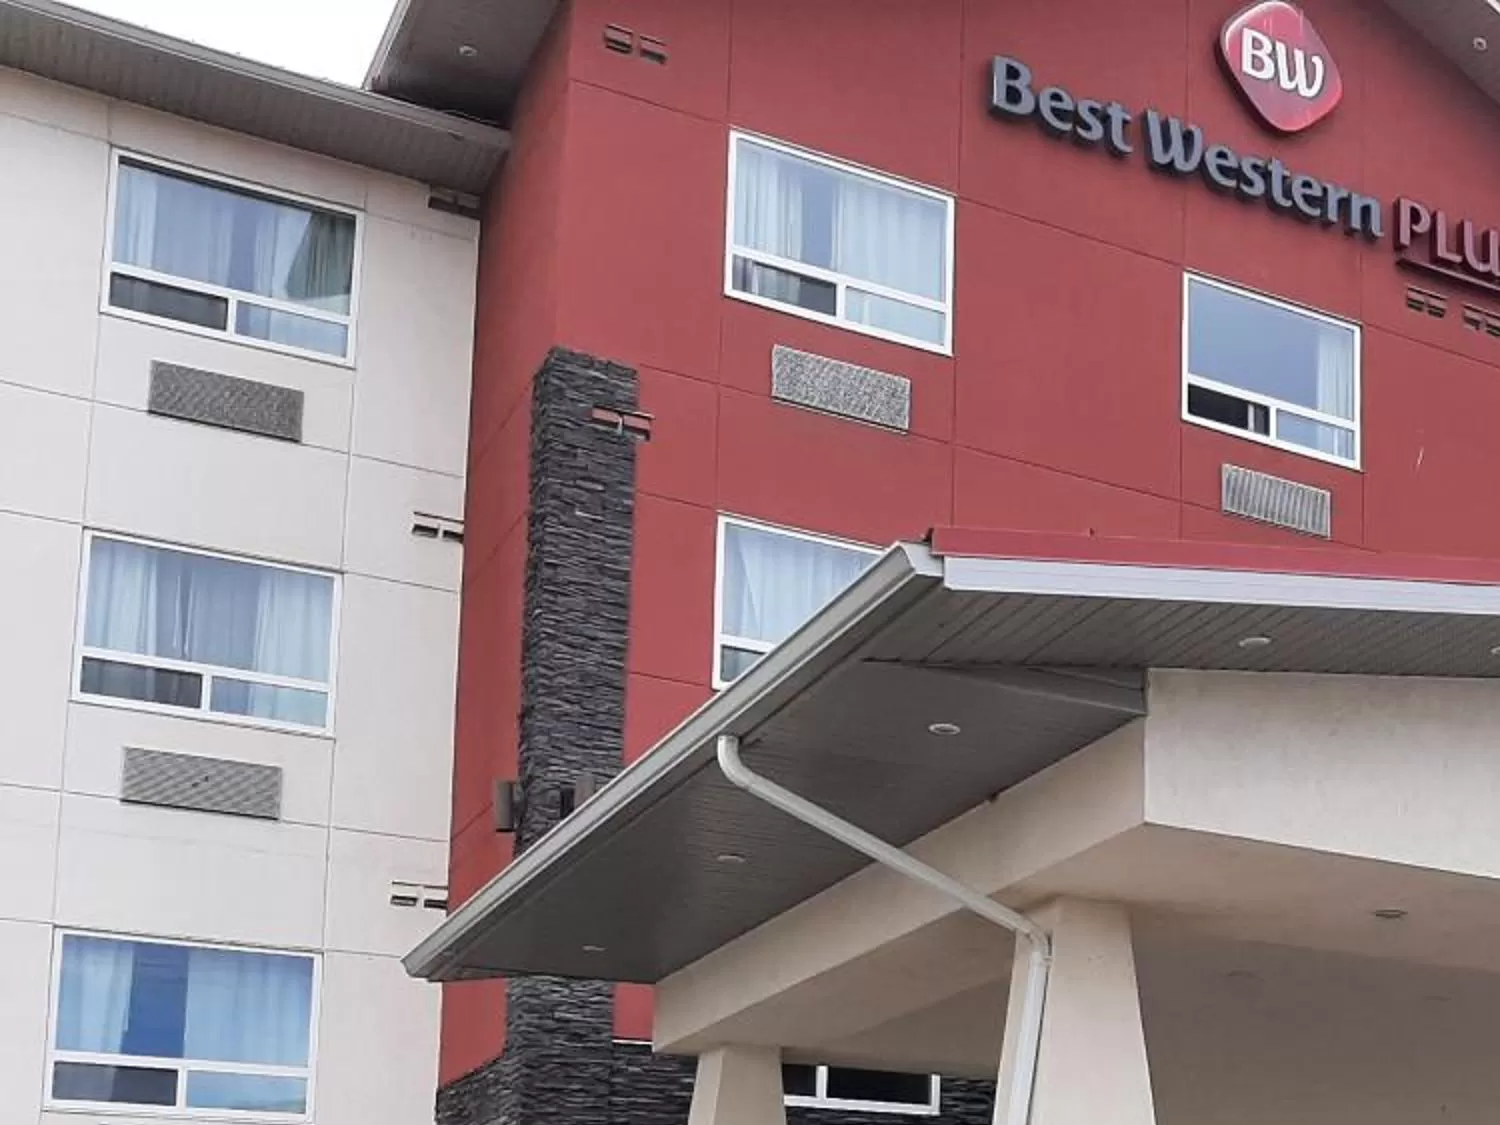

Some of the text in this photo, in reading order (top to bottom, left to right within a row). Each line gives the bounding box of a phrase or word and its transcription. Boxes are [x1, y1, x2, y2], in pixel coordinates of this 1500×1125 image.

[1240, 27, 1325, 98] BW
[989, 55, 1133, 155] Best
[1146, 108, 1385, 240] Western
